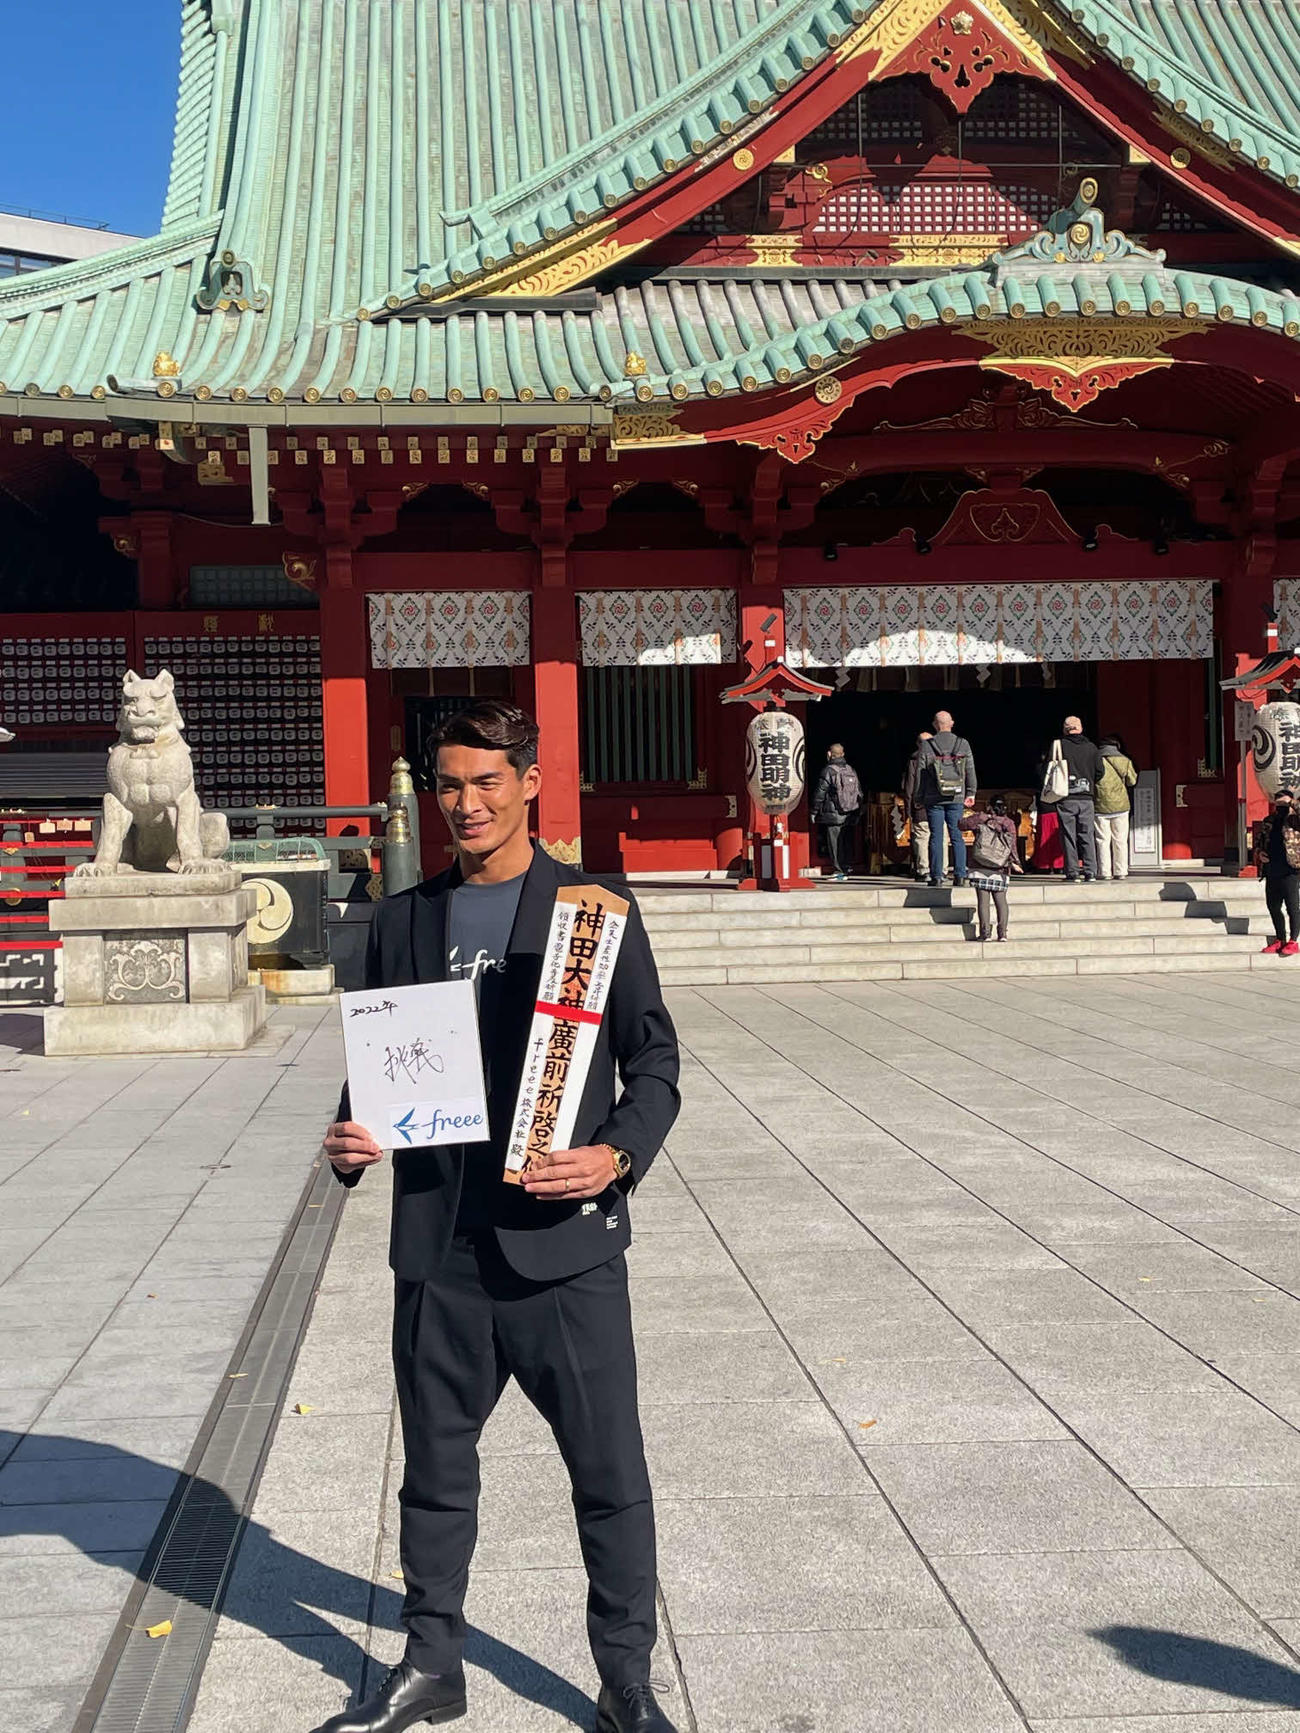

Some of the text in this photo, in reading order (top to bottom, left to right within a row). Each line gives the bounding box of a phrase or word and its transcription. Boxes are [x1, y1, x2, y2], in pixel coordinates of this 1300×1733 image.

[758, 732, 791, 801] 神田明神
[349, 999, 398, 1017] 2022年
[421, 1109, 483, 1140] freee
